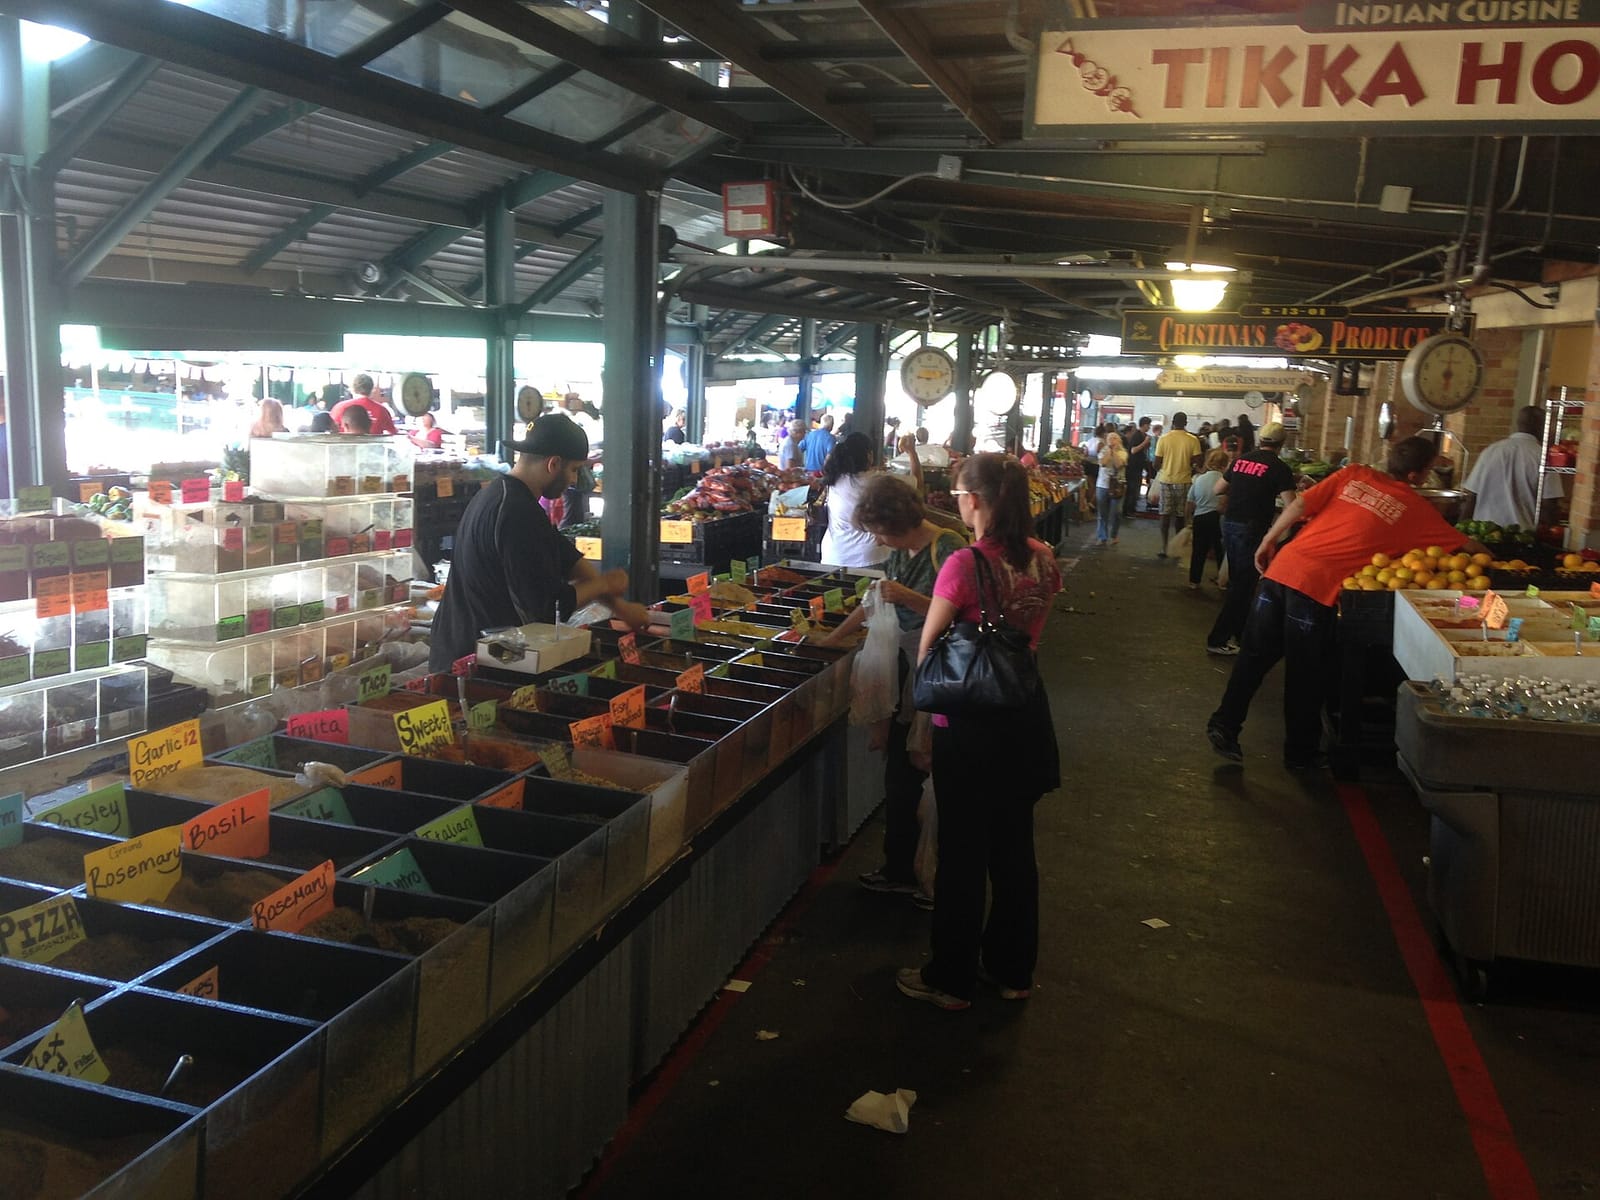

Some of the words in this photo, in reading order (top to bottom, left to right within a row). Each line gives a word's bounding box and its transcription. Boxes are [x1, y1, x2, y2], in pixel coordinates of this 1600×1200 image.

[1336, 0, 1450, 25] INDIAN
[1455, 0, 1580, 22] CUISINE
[1152, 42, 1426, 109] TIKKA
[1235, 374, 1296, 385] RESTAURANT
[1232, 458, 1269, 478] STAFF
[397, 712, 442, 747] Sweet
[135, 739, 182, 765] Garlic
[89, 846, 182, 895] Rosemary
